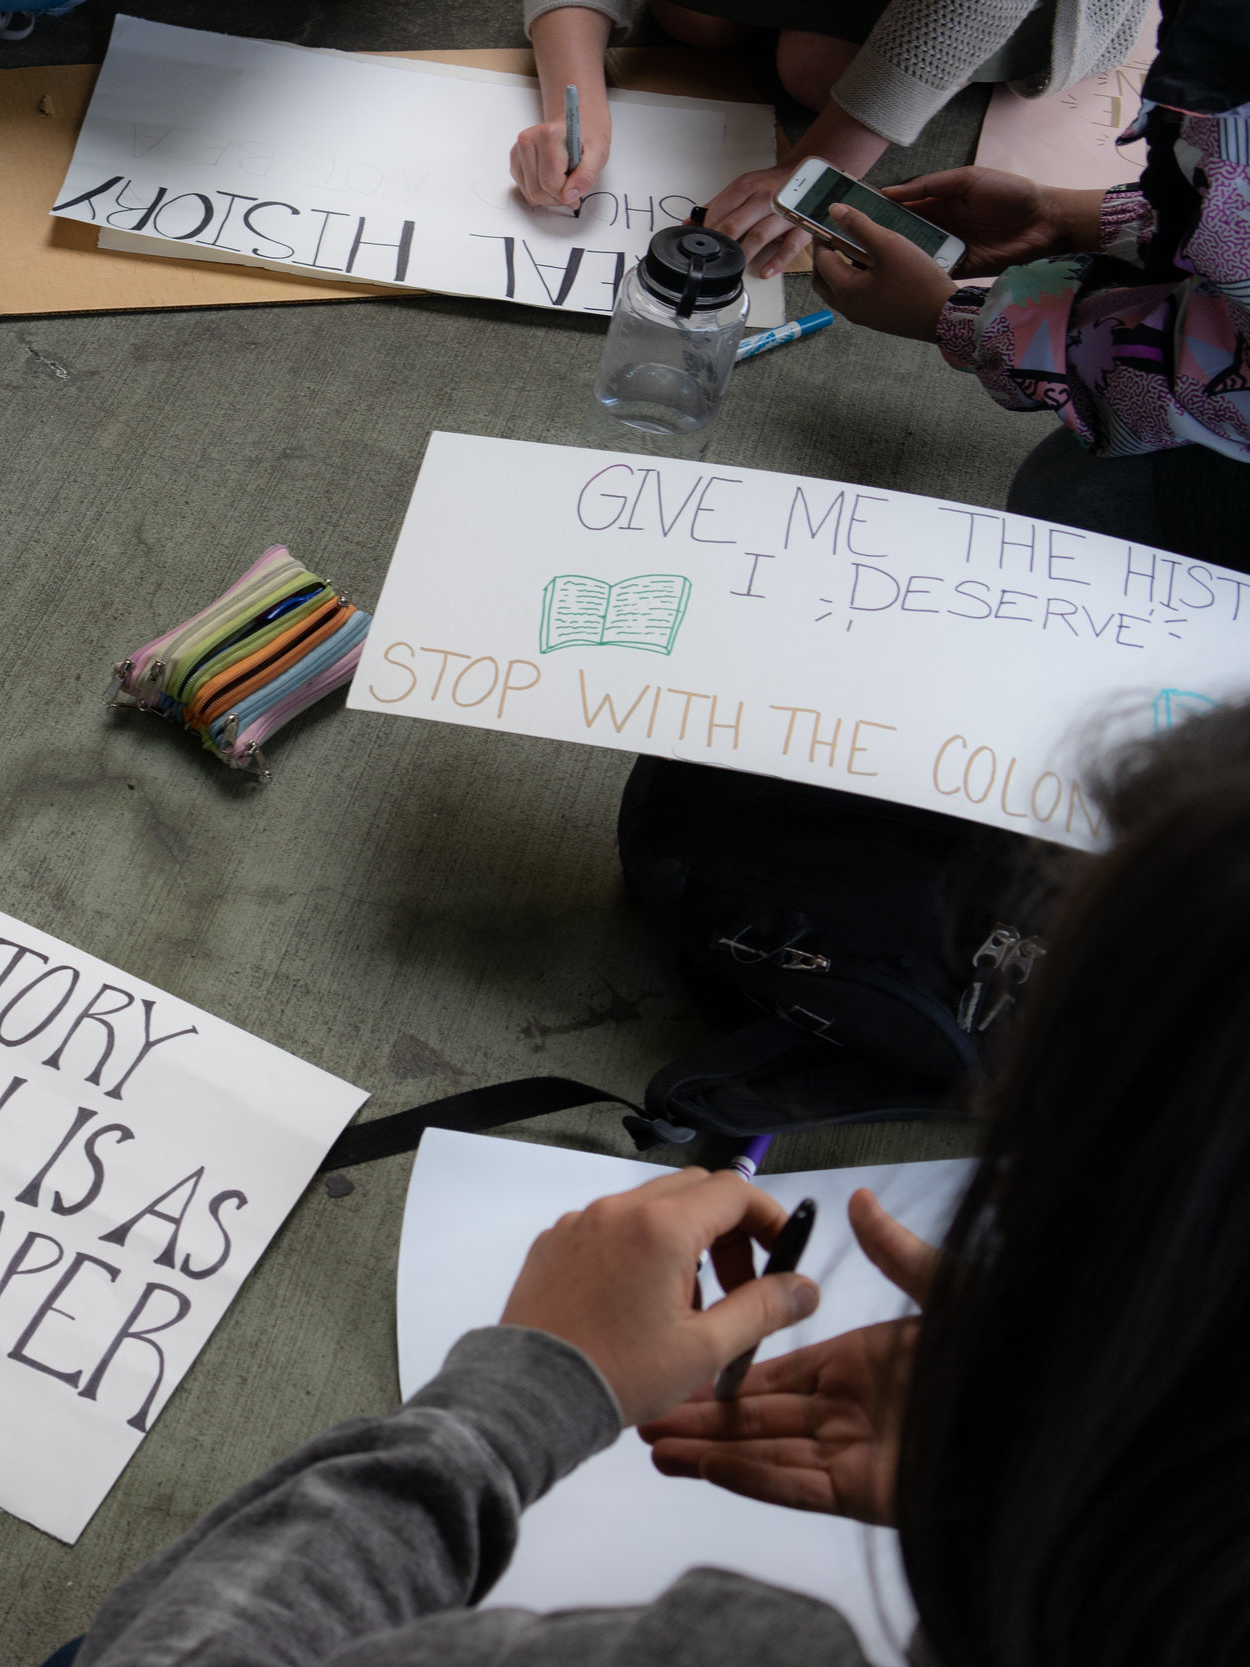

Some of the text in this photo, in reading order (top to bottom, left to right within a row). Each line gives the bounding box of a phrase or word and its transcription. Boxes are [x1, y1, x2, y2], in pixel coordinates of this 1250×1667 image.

[198, 136, 276, 177] BE
[469, 233, 641, 312] EAL
[577, 464, 1250, 621] GIVE ME THE HIST
[730, 552, 1152, 648] I DESERVE
[369, 642, 541, 719] STOP
[578, 669, 743, 749] WITH
[770, 705, 897, 777] THE
[14, 1106, 135, 1216] IS
[98, 1166, 248, 1280] AS
